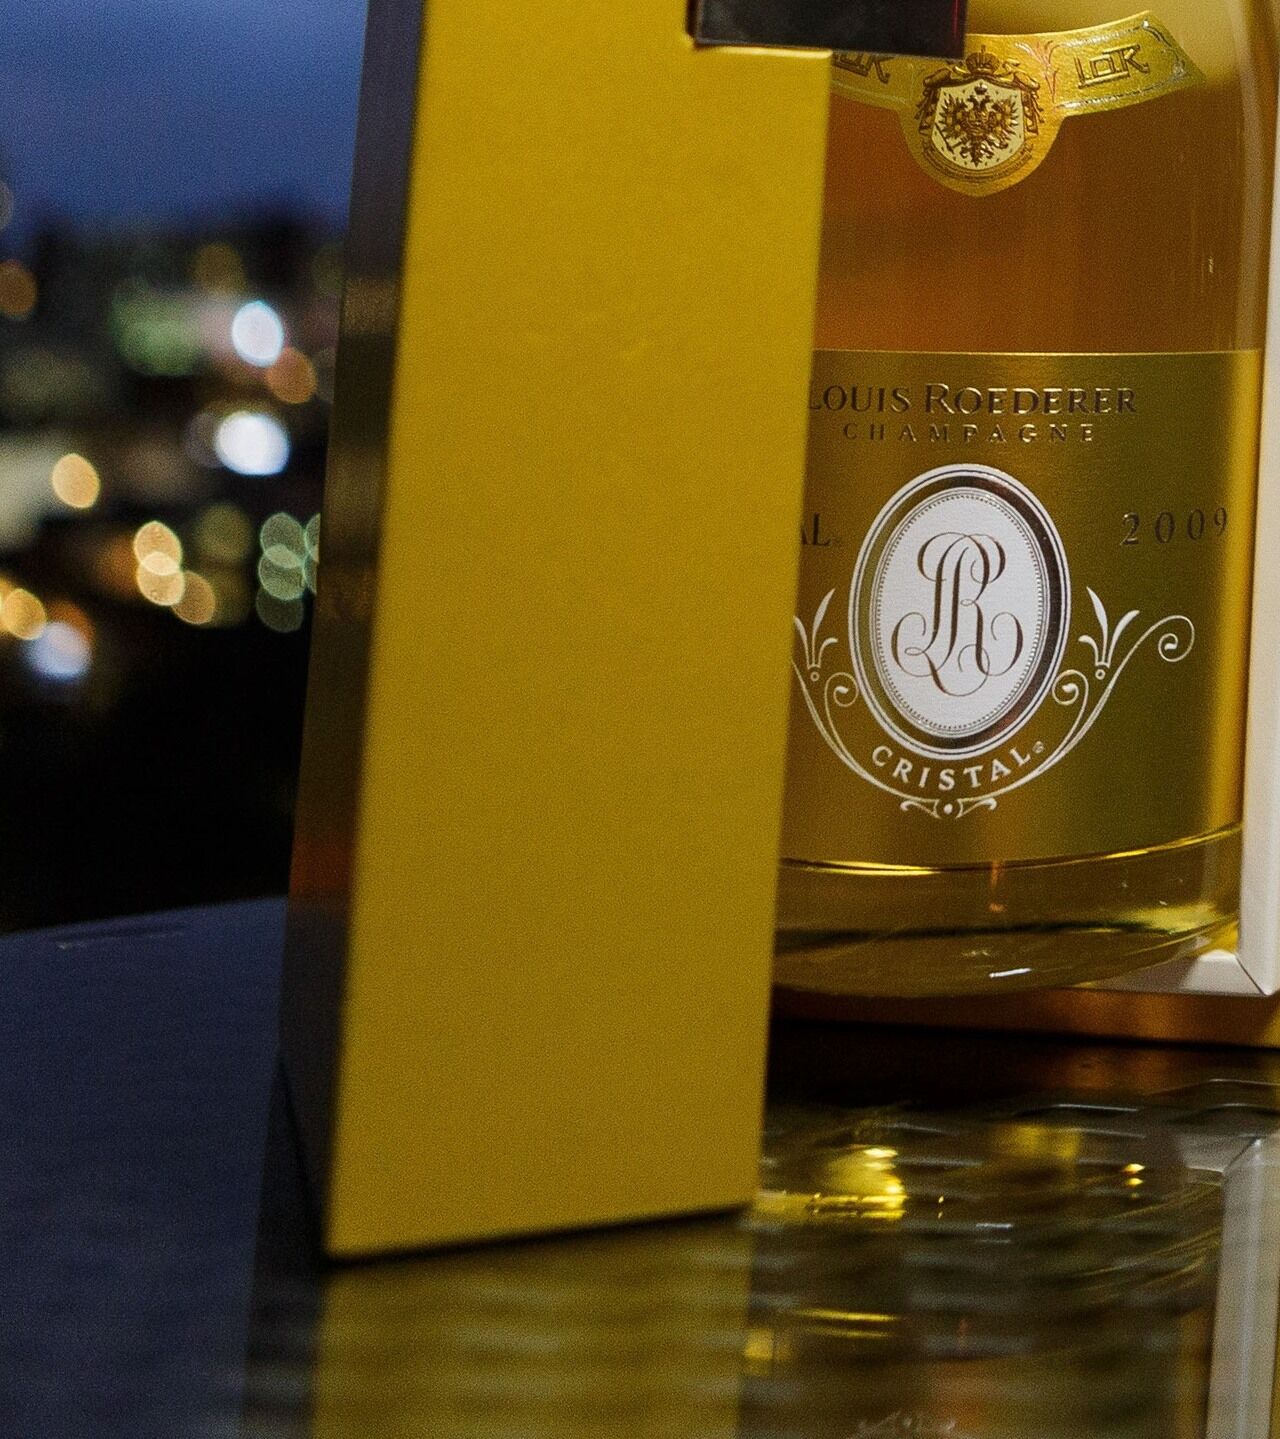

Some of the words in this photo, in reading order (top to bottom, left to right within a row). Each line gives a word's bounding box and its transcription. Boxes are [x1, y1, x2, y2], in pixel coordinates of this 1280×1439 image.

[924, 382, 1137, 416] ROEDERER
[842, 422, 1095, 445] CHAMPAGNE
[1120, 505, 1229, 547] 2009
